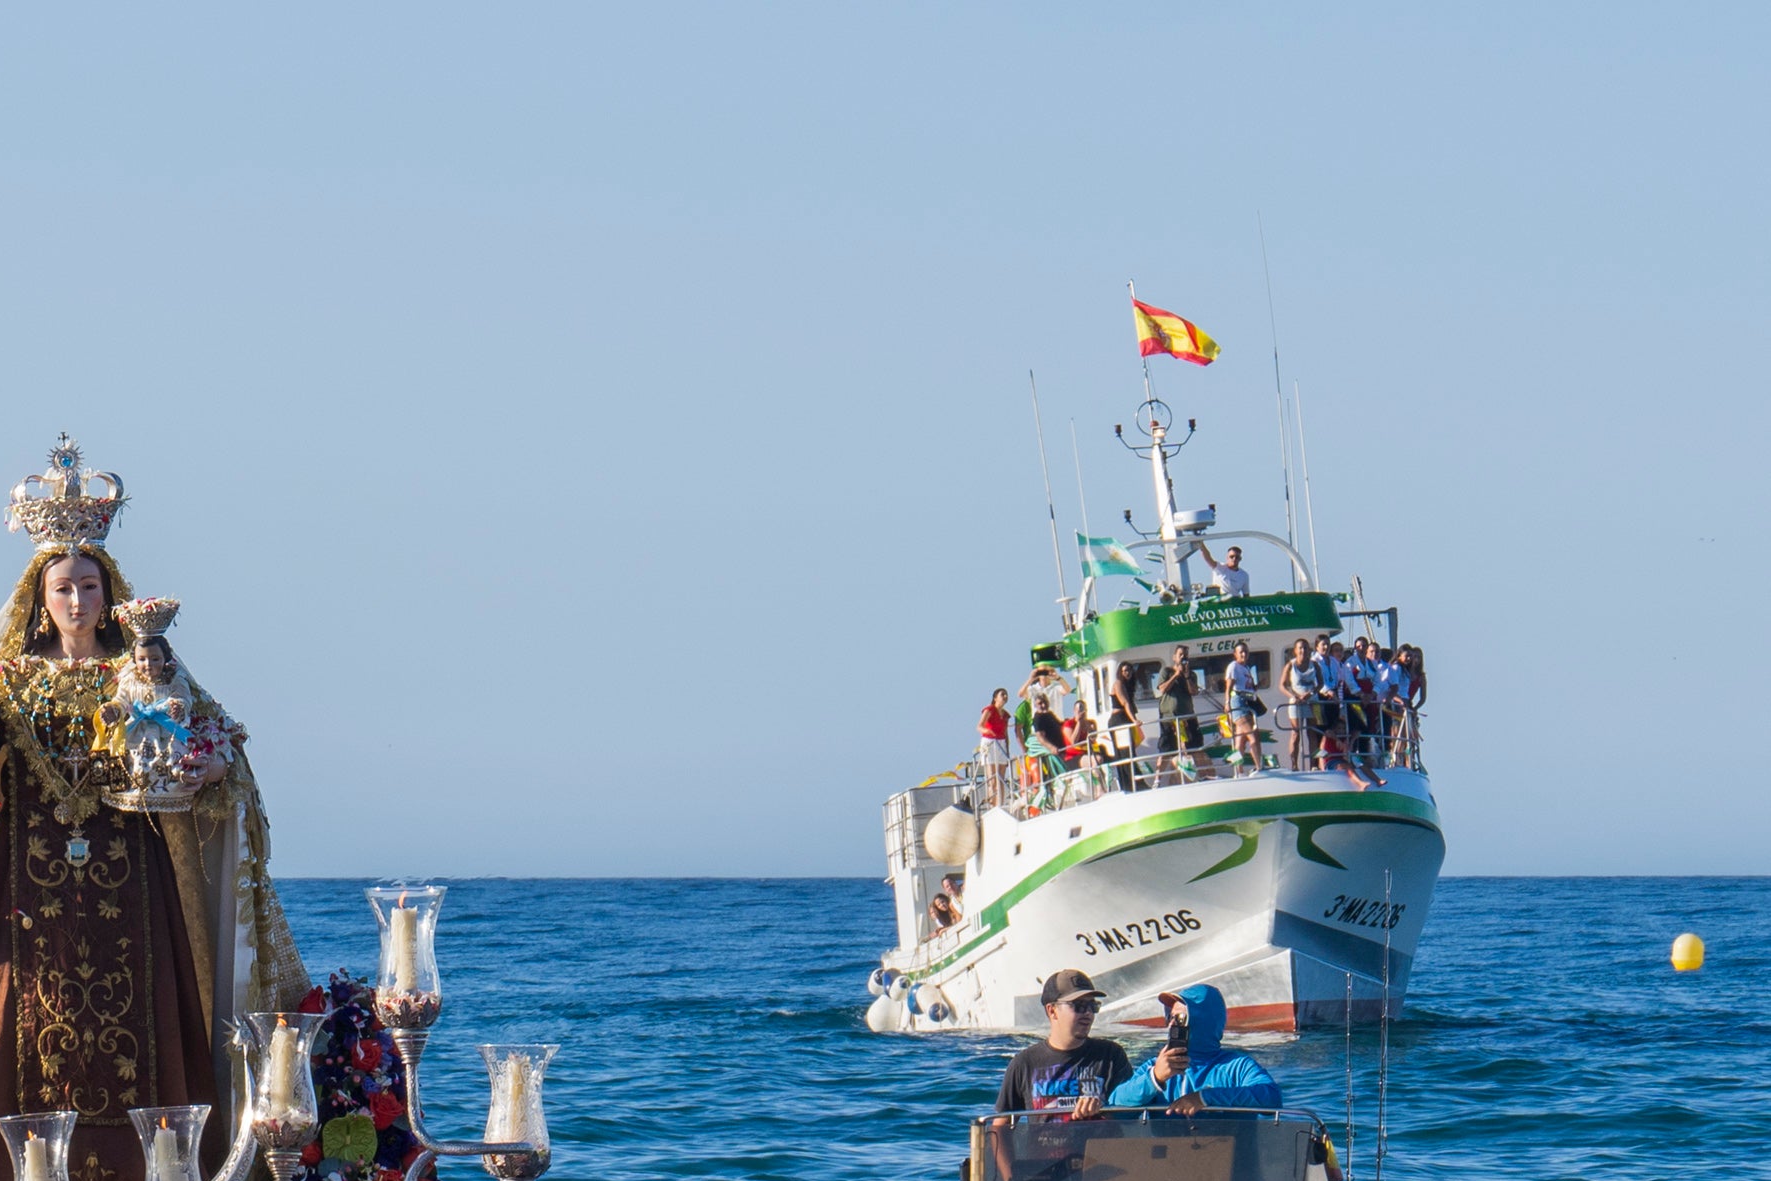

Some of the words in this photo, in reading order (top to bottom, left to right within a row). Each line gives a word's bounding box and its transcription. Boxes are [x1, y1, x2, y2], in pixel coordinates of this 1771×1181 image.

[1169, 608, 1216, 626] NUEVO
[1218, 606, 1243, 619] MIS
[1245, 604, 1295, 616] NIETOS
[1201, 617, 1270, 631] MARBELLA
